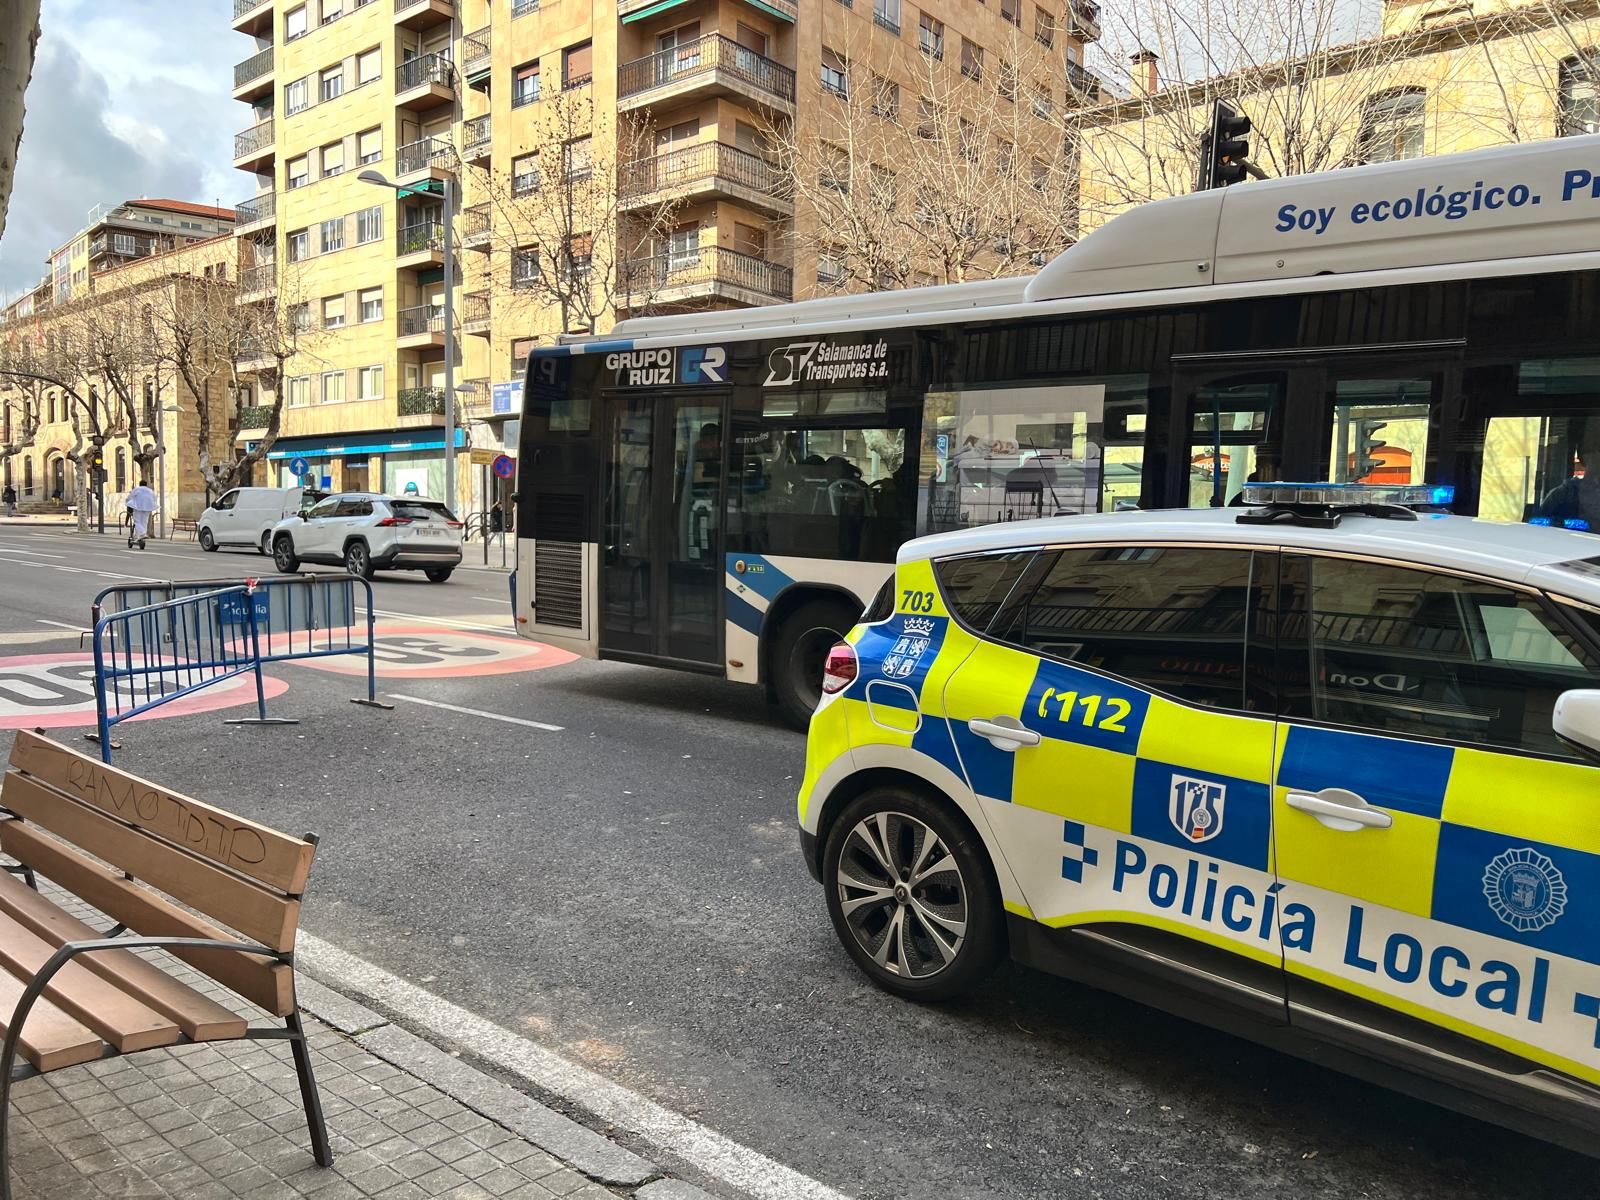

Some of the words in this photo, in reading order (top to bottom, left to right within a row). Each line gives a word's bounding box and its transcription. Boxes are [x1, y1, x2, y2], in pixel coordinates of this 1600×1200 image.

[1275, 204, 1336, 235] Soy
[1350, 180, 1541, 224] ecológico.
[605, 348, 672, 370] GRUPO
[818, 341, 872, 362] Salamanca
[874, 338, 888, 358] de
[629, 367, 671, 385] RUIZ
[806, 360, 867, 384] Transportes
[868, 361, 889, 377] s.a.
[901, 590, 935, 613] 703
[1055, 691, 1132, 733] 112
[1175, 781, 1222, 837] 175
[1112, 839, 1317, 952] Policía
[1343, 905, 1550, 1023] Local
